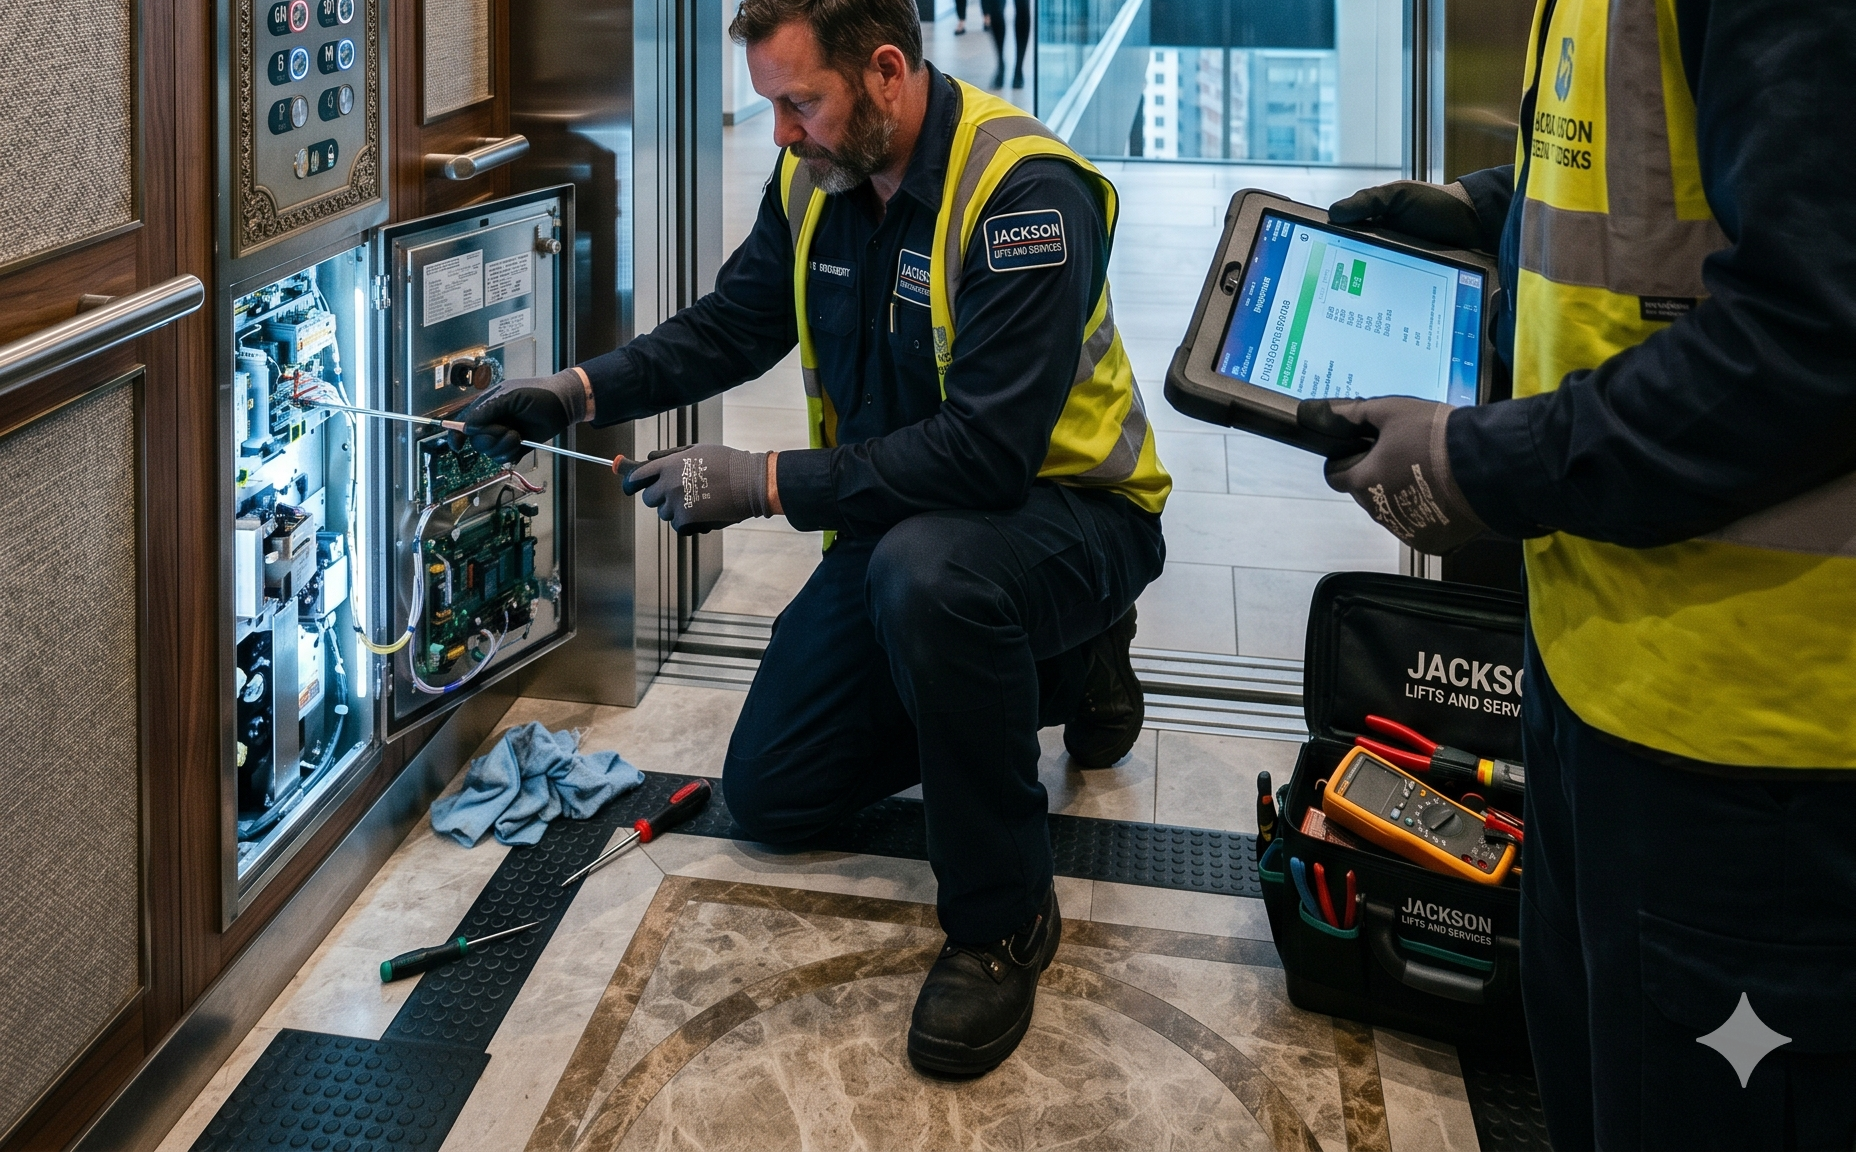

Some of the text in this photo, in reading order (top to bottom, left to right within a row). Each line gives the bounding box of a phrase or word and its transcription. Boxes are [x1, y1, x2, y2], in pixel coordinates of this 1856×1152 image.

[992, 223, 1060, 245] JACKSON
[1405, 683, 1445, 704] LIFTS
[1447, 692, 1480, 710] AND
[1401, 897, 1492, 935] JACKSON
[1401, 914, 1492, 946] LIFTS AND SERVICES
